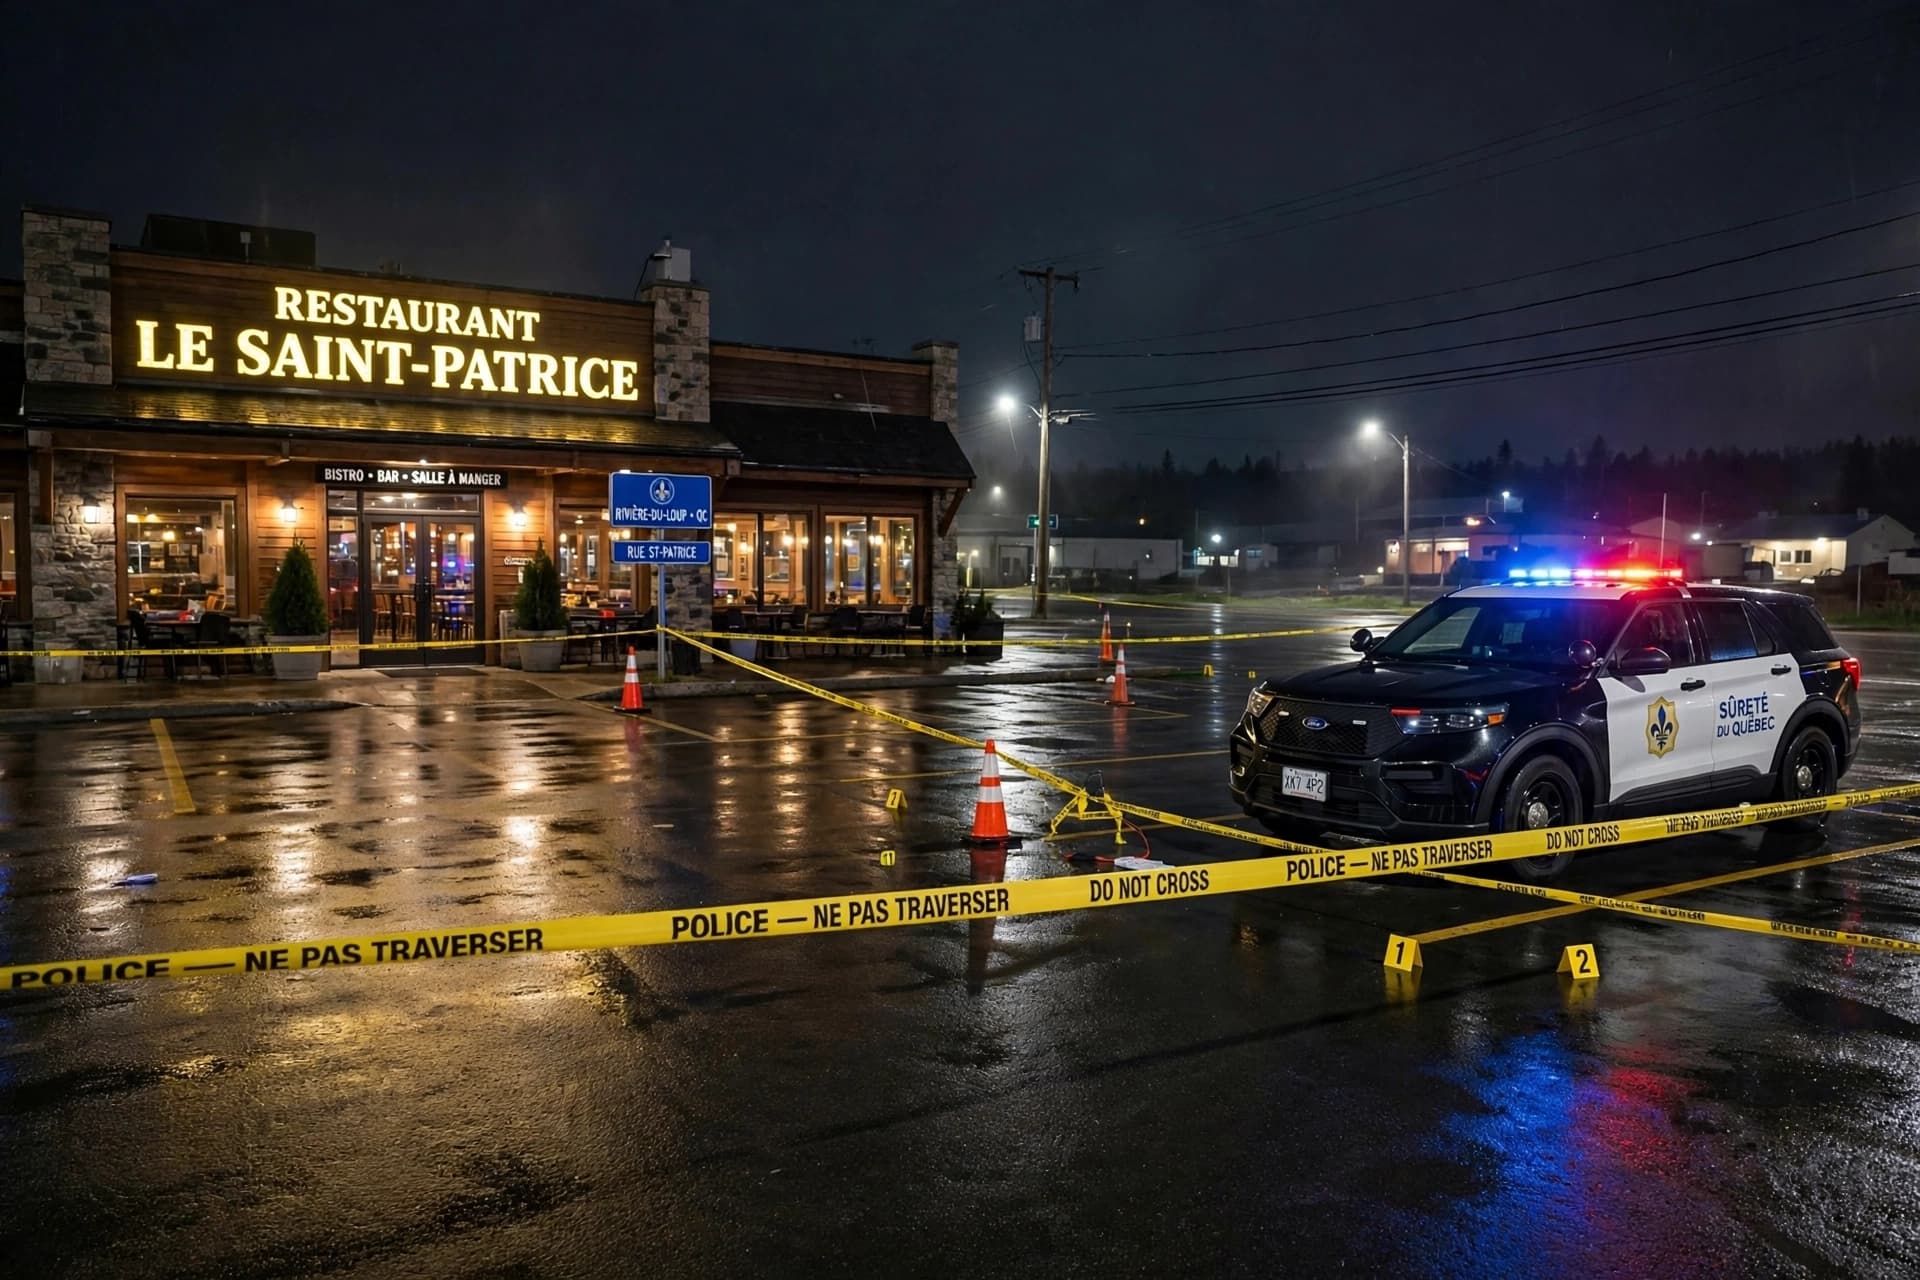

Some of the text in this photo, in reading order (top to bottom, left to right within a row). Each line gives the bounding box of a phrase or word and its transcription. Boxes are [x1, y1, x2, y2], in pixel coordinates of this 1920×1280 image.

[274, 286, 540, 342] RESTAURANT
[136, 320, 639, 401] LE SAINT-PATRICE
[324, 468, 501, 486] BISTRO BAR SALLE À MANGER
[615, 504, 708, 522] RIVIÈRE-DU-LOUP QC
[627, 545, 697, 559] RUE ST-PATRICE
[1717, 691, 1775, 738] SÛRETÉ DU QUÉBEC
[1306, 777, 1324, 794] 4P2
[1546, 825, 1620, 849] DO NOT CROSS
[1287, 840, 1492, 881] POLICE NE PAS TRAVERSER
[1090, 870, 1209, 902] DO NOT CROSS
[672, 888, 1009, 940] POLICE NE PAS TRAVERSER
[11, 928, 544, 988] POLICE NE PAS TRAVERSER
[1396, 941, 1405, 965] 1
[1576, 949, 1591, 973] 2
